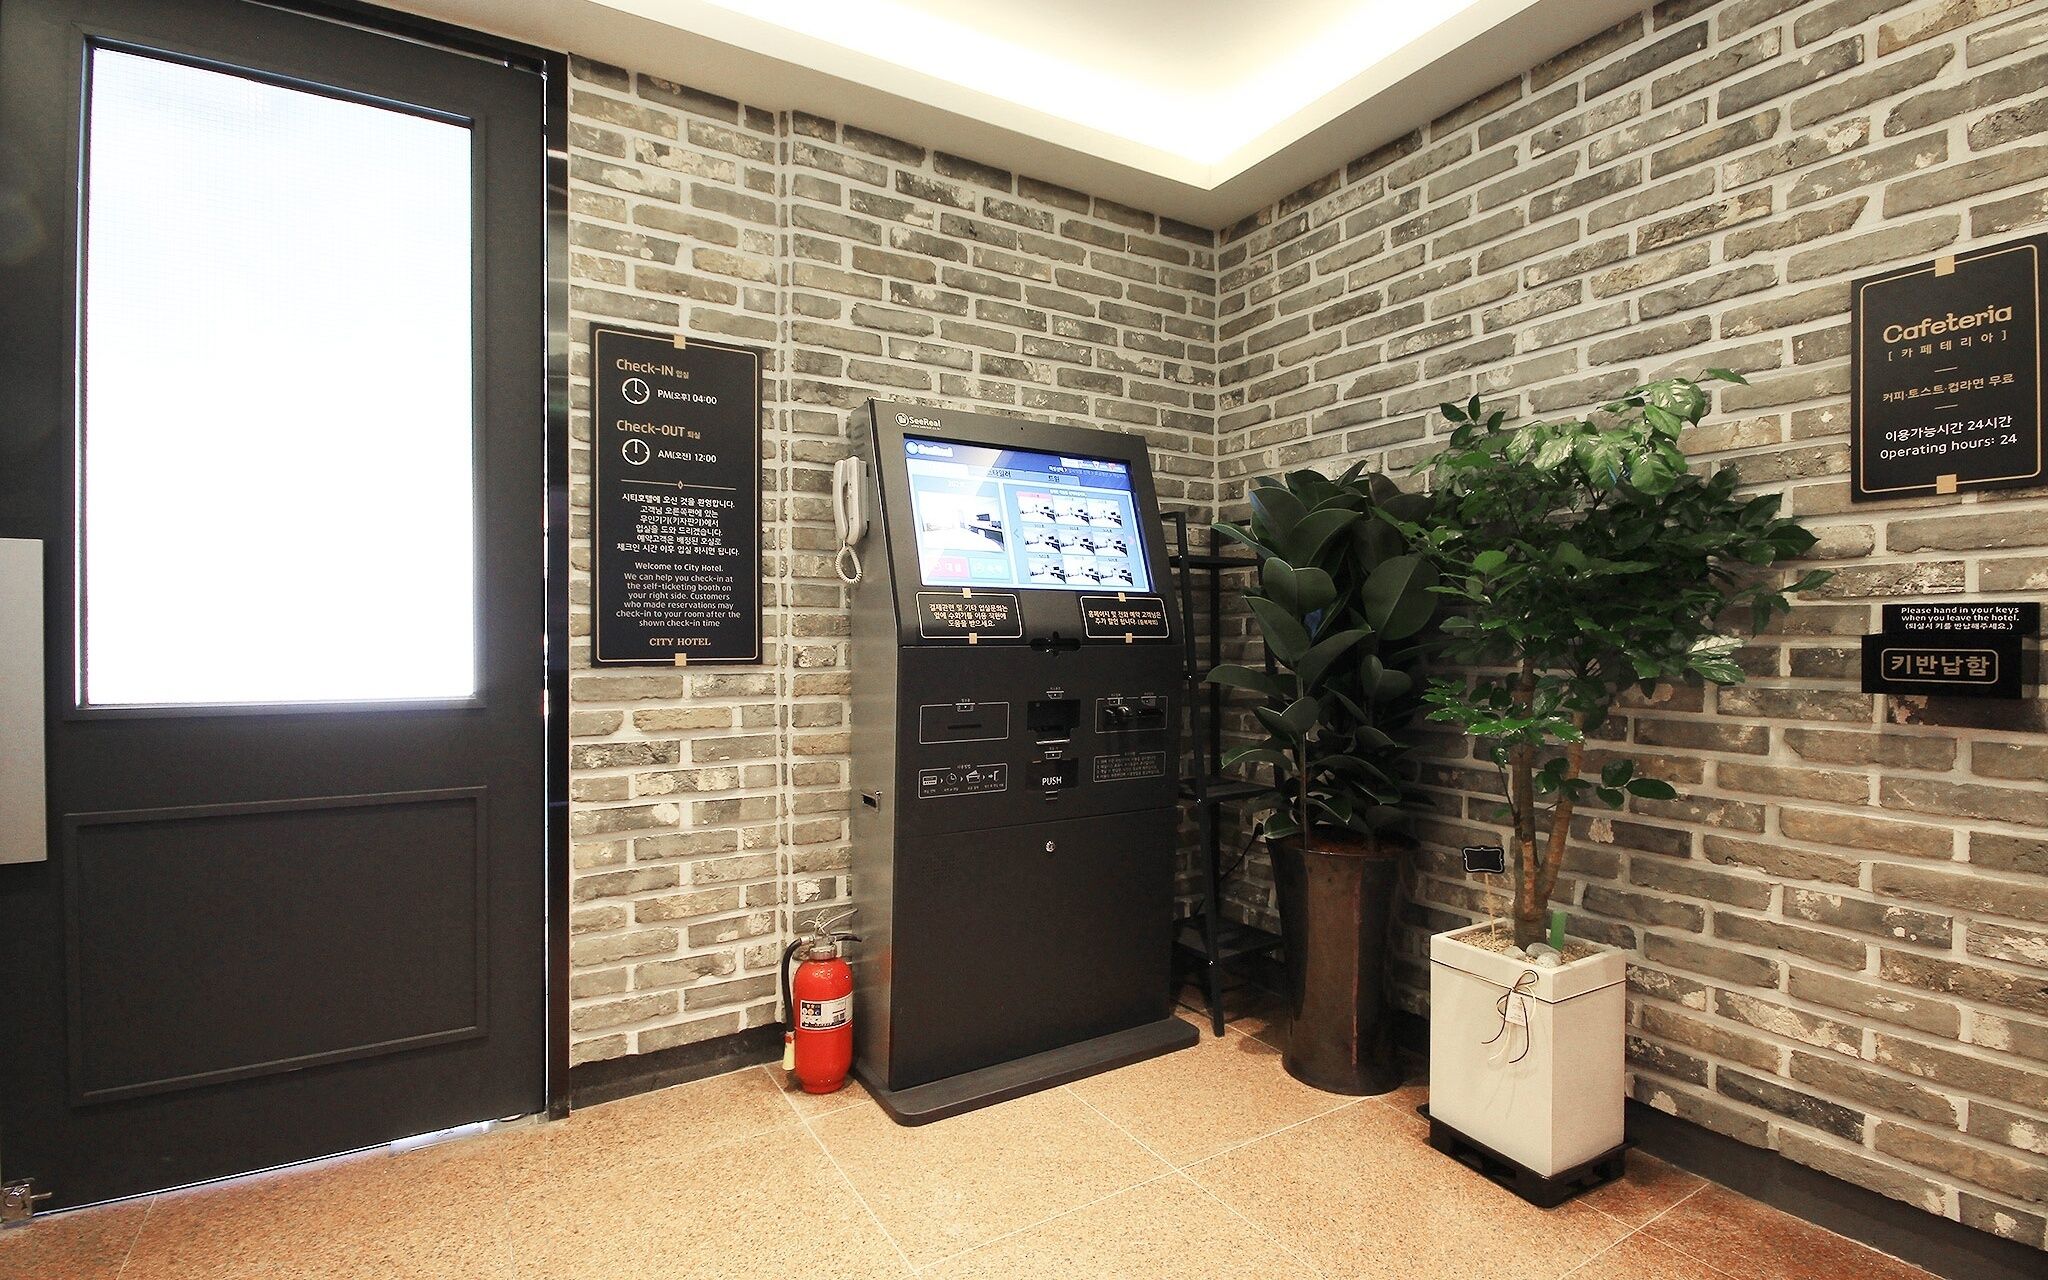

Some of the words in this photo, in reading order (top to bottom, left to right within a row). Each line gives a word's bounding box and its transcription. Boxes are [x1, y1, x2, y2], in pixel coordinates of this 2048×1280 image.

[1882, 304, 2013, 344] Cafeteria
[616, 359, 673, 376] Check-IN
[1988, 373, 2015, 387] 무료
[692, 394, 718, 404] 04:00
[909, 415, 942, 428] SeeReal
[616, 420, 686, 437] Check-OUT
[1885, 422, 1964, 442] 이용가능시간
[1967, 415, 2013, 431] 24시간
[1880, 443, 1947, 460] Operating
[1951, 437, 1995, 452] hours:
[2000, 434, 2018, 445] 24
[694, 453, 717, 463] 12:00
[622, 494, 661, 503] 시티호텔에
[662, 496, 678, 505] 오신
[680, 497, 695, 506] 것을
[697, 498, 735, 508] 환영합니다.
[640, 505, 662, 515] 고객님
[704, 509, 718, 518] 있는
[635, 524, 659, 534] 입실을
[660, 526, 677, 535] 도와
[678, 526, 723, 537] 드리겠습니다.
[636, 535, 675, 544] 예약고객은
[616, 543, 640, 552] 체크인
[642, 544, 658, 553] 시간
[659, 545, 675, 554] 이후
[677, 546, 692, 555] 입실
[634, 562, 672, 571] Welcome
[673, 563, 683, 571] to
[684, 564, 700, 572] City
[701, 564, 724, 572] Hotel.
[623, 572, 637, 581] We
[639, 573, 654, 581] can
[655, 574, 673, 582] help
[674, 575, 690, 583] you
[690, 574, 724, 583] check-in
[626, 582, 641, 590] the
[642, 583, 697, 592] self-ticketing
[697, 583, 721, 592] booth
[628, 592, 647, 600] your
[648, 592, 669, 601] right
[670, 592, 689, 600] side.
[690, 592, 731, 601] Customers
[623, 601, 642, 609] who
[643, 601, 666, 609] made
[667, 601, 717, 610] reservations
[717, 602, 735, 611] may
[1933, 606, 1958, 614] hand
[1959, 606, 1969, 614] in
[1970, 607, 1994, 615] your
[1995, 606, 2020, 614] keys
[615, 609, 652, 618] check-in
[653, 610, 663, 618] to
[664, 611, 683, 619] your
[706, 610, 726, 618] after
[727, 611, 741, 619] the
[1901, 614, 1927, 622] when
[1928, 615, 1946, 623] you
[1946, 614, 1972, 622] leave
[1973, 614, 1991, 622] the
[639, 619, 665, 628] shown
[666, 619, 701, 628] check-in
[701, 619, 721, 628] time
[649, 637, 674, 647] CITY
[677, 637, 712, 647] HOTEL
[1891, 654, 1990, 677] 키반납함
[1041, 776, 1062, 786] PUSH
